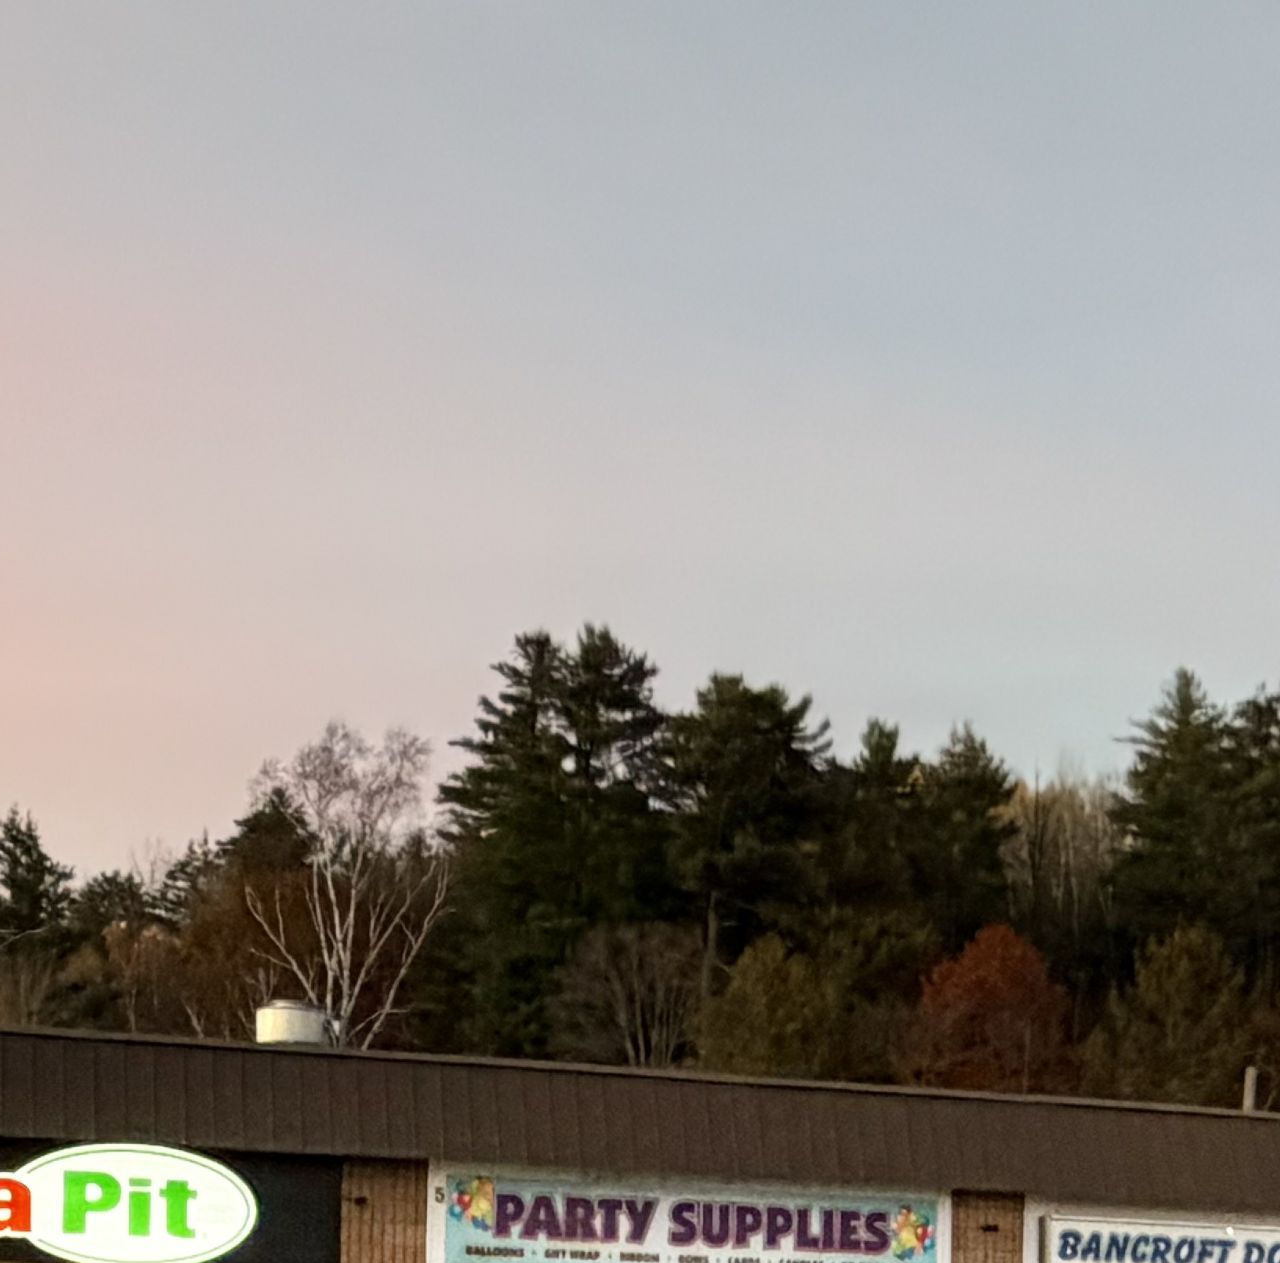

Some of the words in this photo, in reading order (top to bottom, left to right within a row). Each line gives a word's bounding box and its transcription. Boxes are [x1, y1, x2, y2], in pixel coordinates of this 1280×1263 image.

[62, 1169, 197, 1239] Pit
[434, 1186, 445, 1204] 5
[493, 1192, 659, 1245] PARTY
[668, 1199, 892, 1256] SUPPLIES
[465, 1245, 525, 1259] BALLOONS
[544, 1248, 567, 1260] GIFT
[569, 1249, 601, 1262] WRAP
